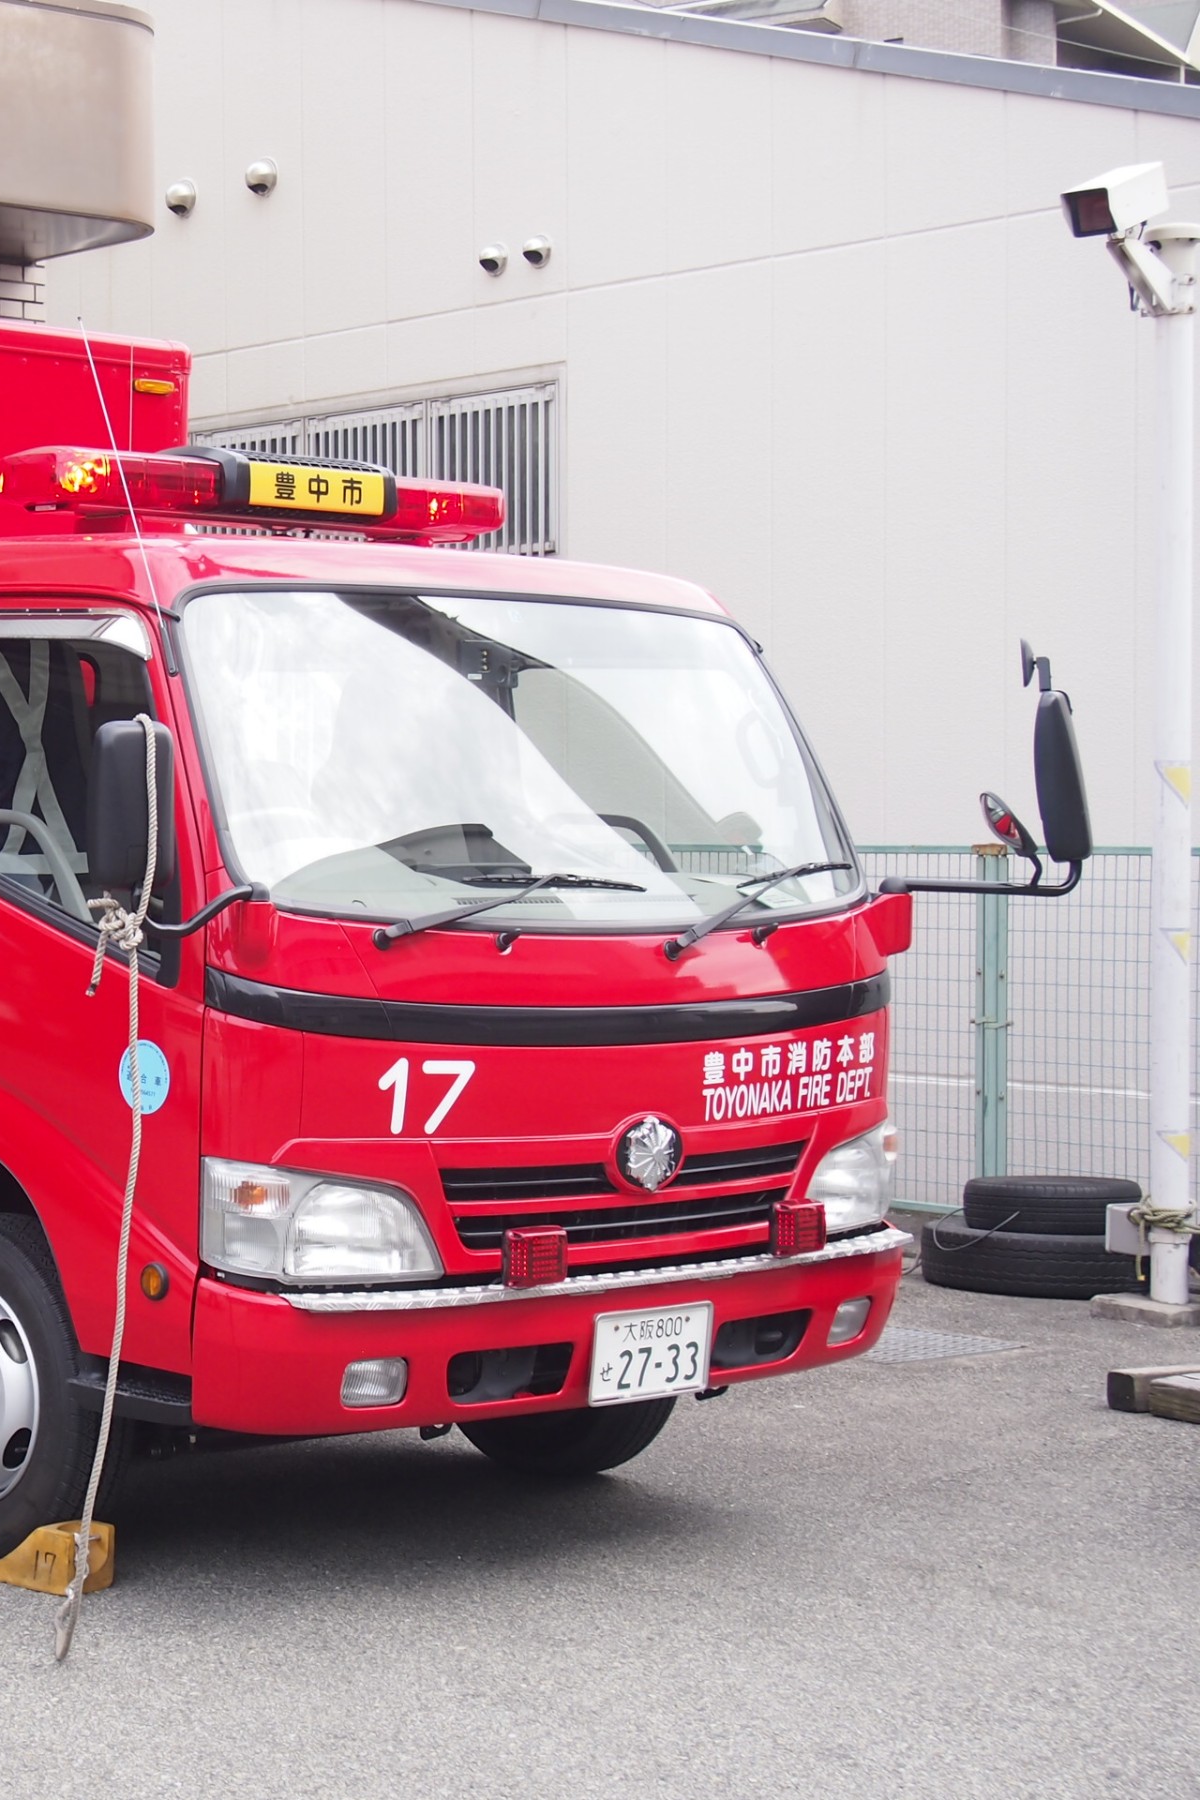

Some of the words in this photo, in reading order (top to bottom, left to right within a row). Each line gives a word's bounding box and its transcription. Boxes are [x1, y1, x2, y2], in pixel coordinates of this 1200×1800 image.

[275, 471, 362, 506] 豊中市
[702, 1032, 875, 1085] 豊中市消防本部
[378, 1057, 476, 1135] 17
[702, 1079, 792, 1122] TOYONAKA
[797, 1073, 833, 1109] FIRE
[836, 1066, 873, 1103] DEPT.
[600, 1363, 613, 1382] せ
[617, 1341, 699, 1390] 27-33
[33, 1549, 56, 1586] 17
